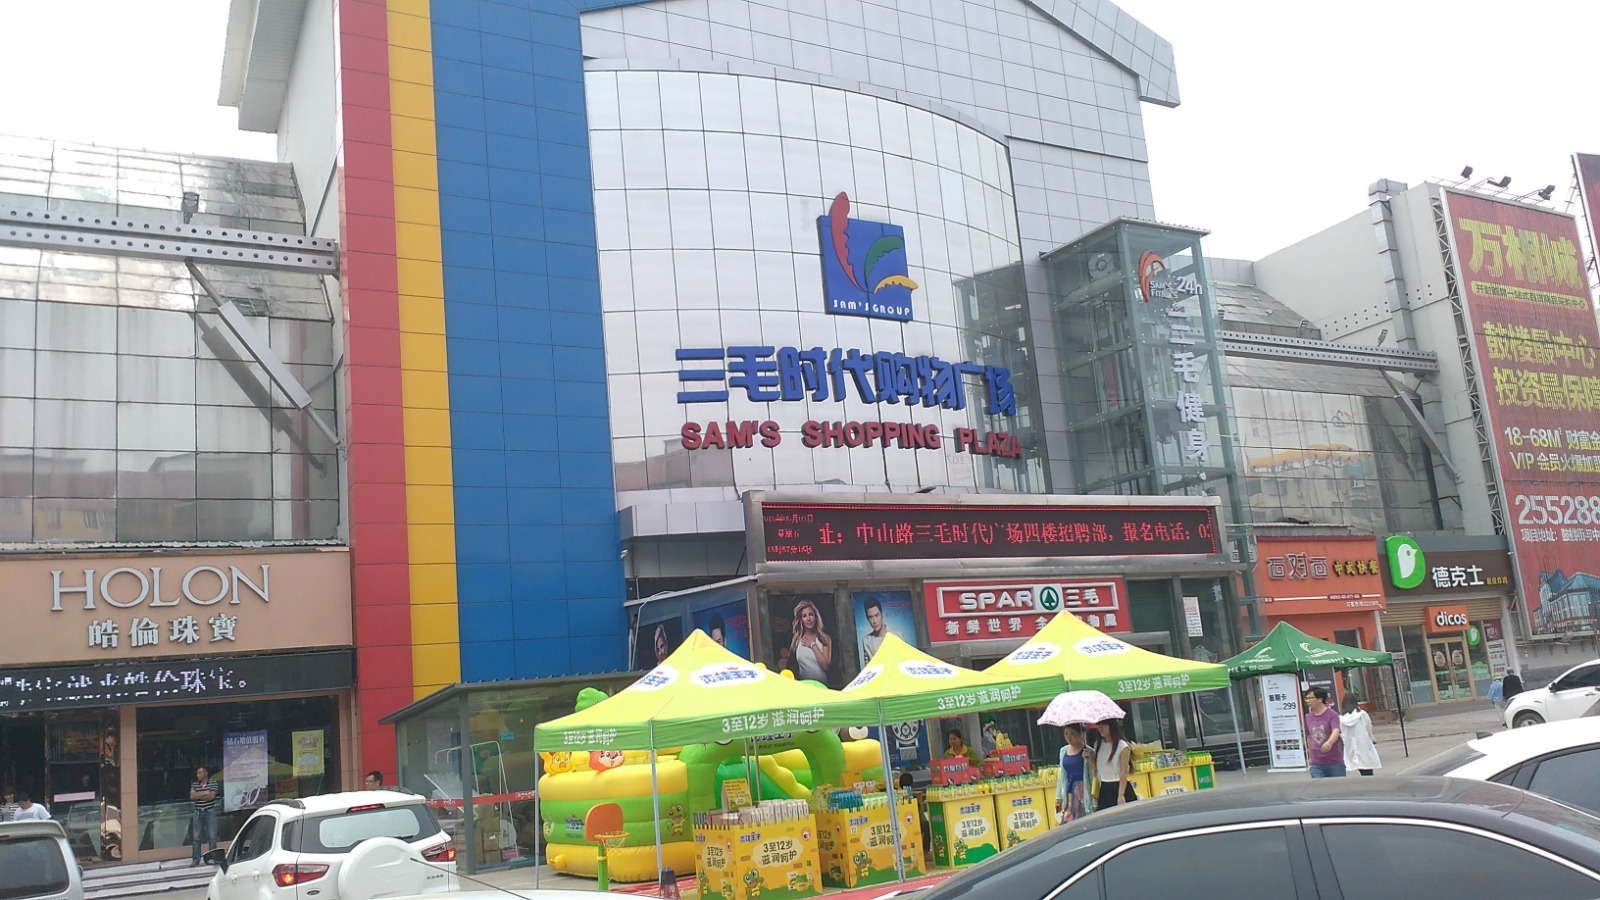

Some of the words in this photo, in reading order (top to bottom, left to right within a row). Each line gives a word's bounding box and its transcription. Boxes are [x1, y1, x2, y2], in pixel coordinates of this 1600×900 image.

[1176, 275, 1203, 295] 24h
[872, 303, 911, 316] GROUP
[675, 346, 1017, 416] 三毛时代购物广场
[1167, 309, 1211, 462] 三毛健身
[681, 420, 782, 450] SAM'S
[801, 420, 941, 450] SHOPPING
[953, 427, 1024, 459] PLAZA
[1510, 452, 1534, 470] VIP
[1266, 552, 1329, 580] 面对面
[1333, 559, 1379, 577] 中式快餐
[1431, 564, 1485, 588] 德克士
[50, 564, 270, 611] HOLON
[958, 590, 1033, 610] SPAR
[1065, 588, 1100, 606] 三毛
[1435, 611, 1468, 626] dicos
[1117, 676, 1151, 692] 3至12岁
[1151, 673, 1190, 689] 滋润呵护
[937, 692, 976, 710] 3至12岁
[977, 684, 1022, 705] 滋润呵护
[1282, 702, 1297, 710] 299
[722, 713, 769, 733] 3至12岁
[771, 707, 825, 728] 滋润呵护
[870, 824, 892, 836] 3至12
[763, 839, 794, 853] 3至12岁
[869, 835, 895, 848] 滋润呵
[761, 850, 798, 866] 滋润呵护
